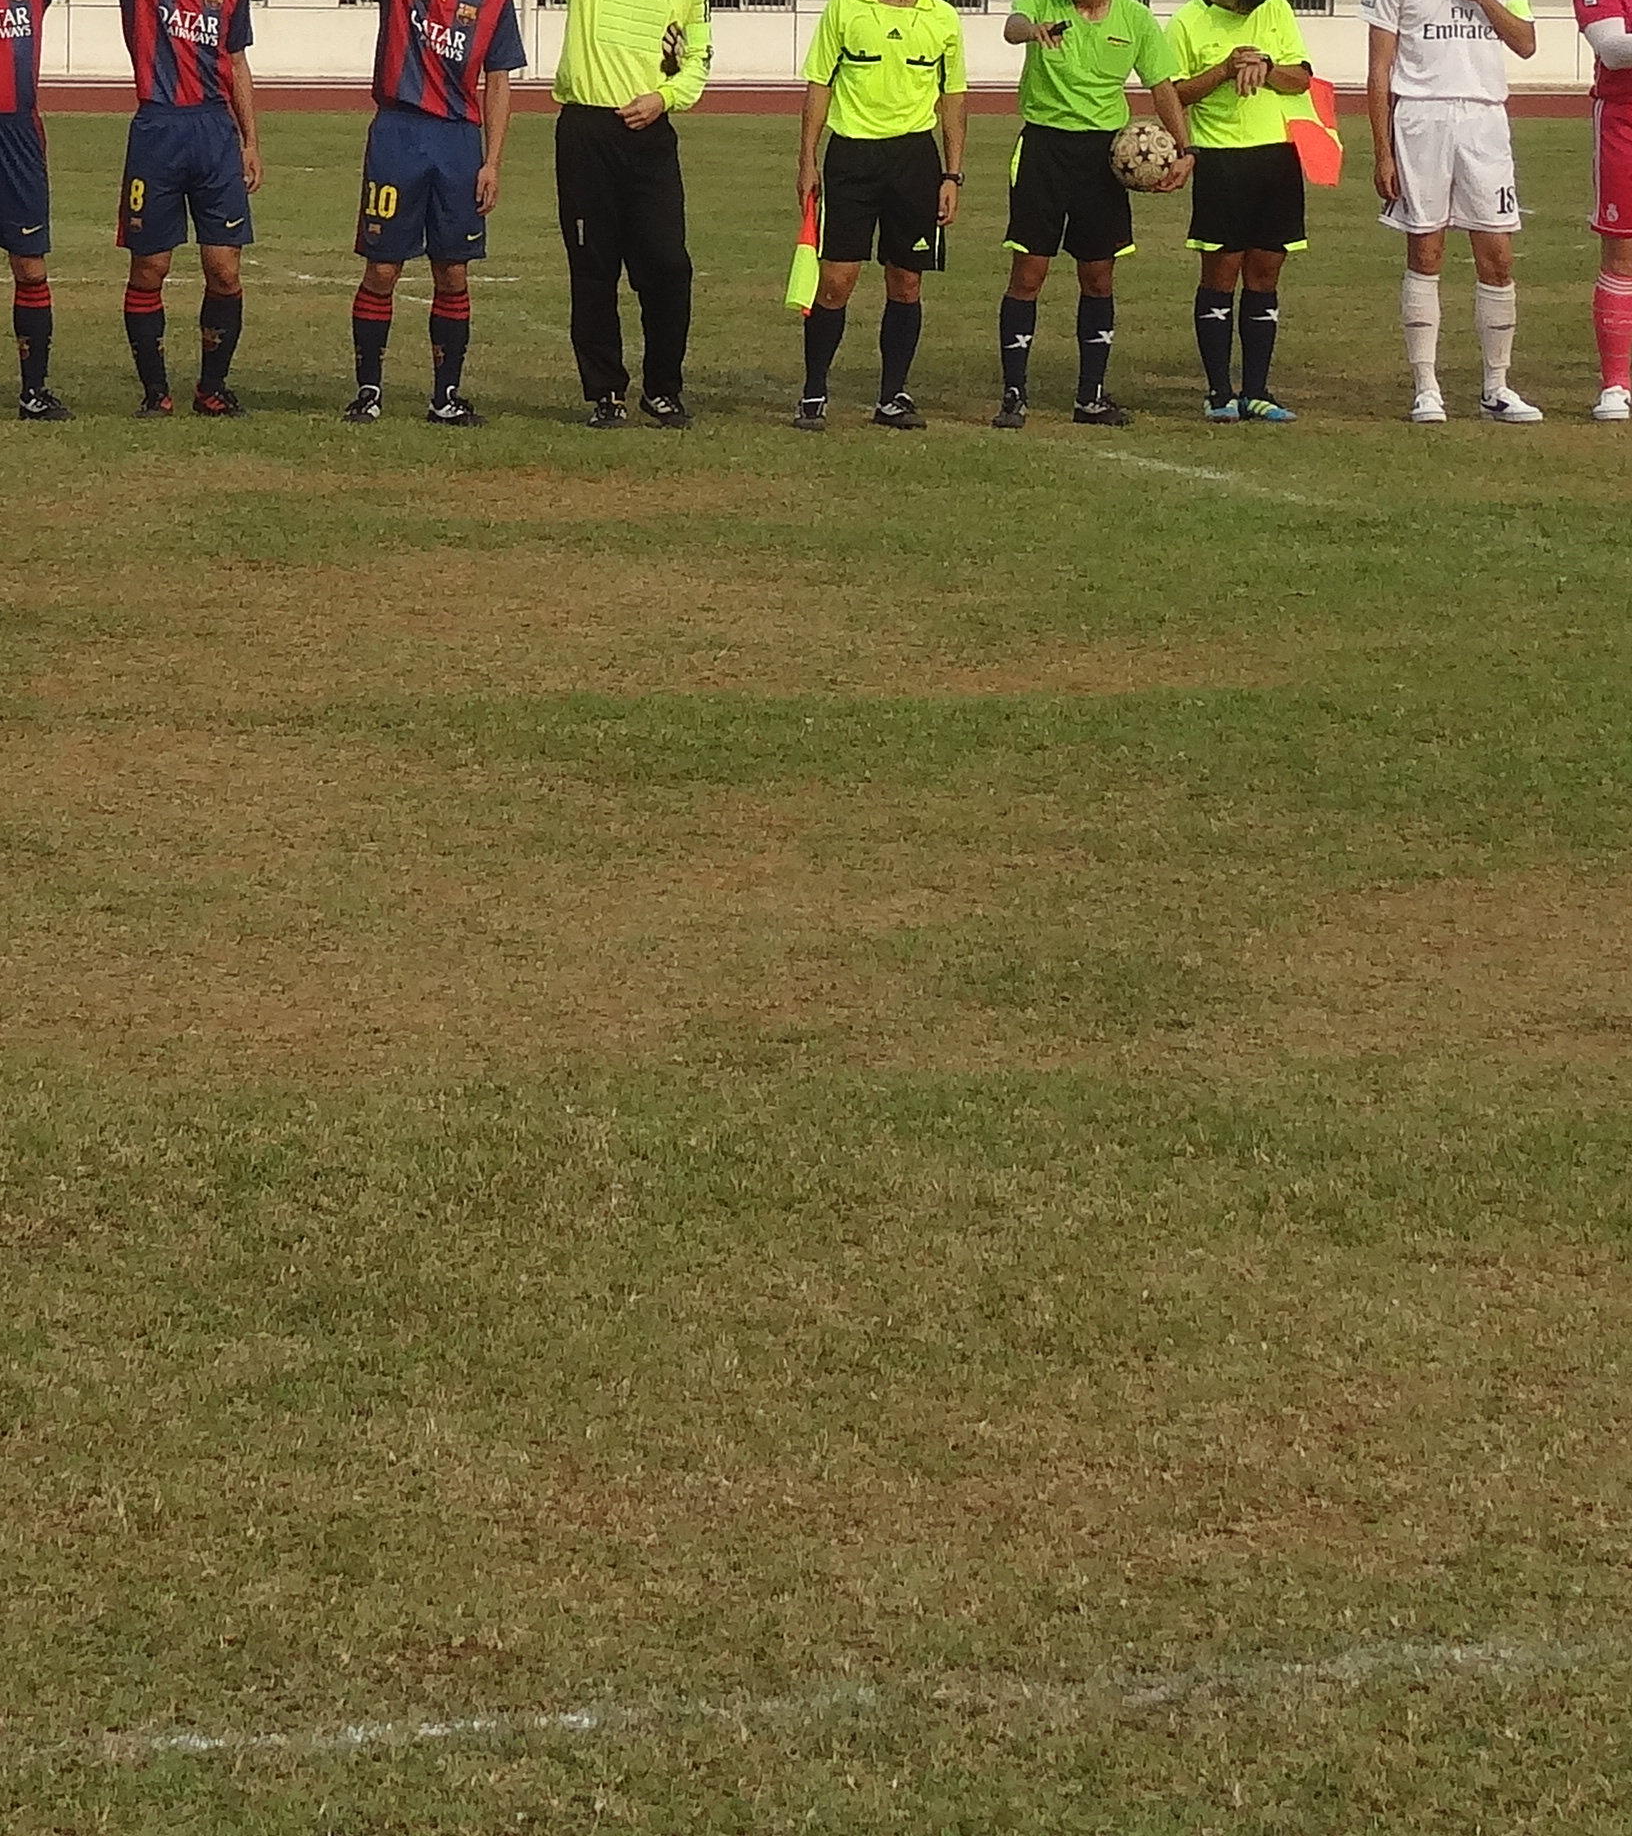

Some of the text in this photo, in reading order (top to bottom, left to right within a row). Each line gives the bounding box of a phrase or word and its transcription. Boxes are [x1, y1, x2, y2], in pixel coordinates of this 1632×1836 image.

[1451, 6, 1473, 21] Fly
[1423, 20, 1499, 40] Emirate
[130, 179, 144, 211] 8
[366, 182, 397, 218] 10
